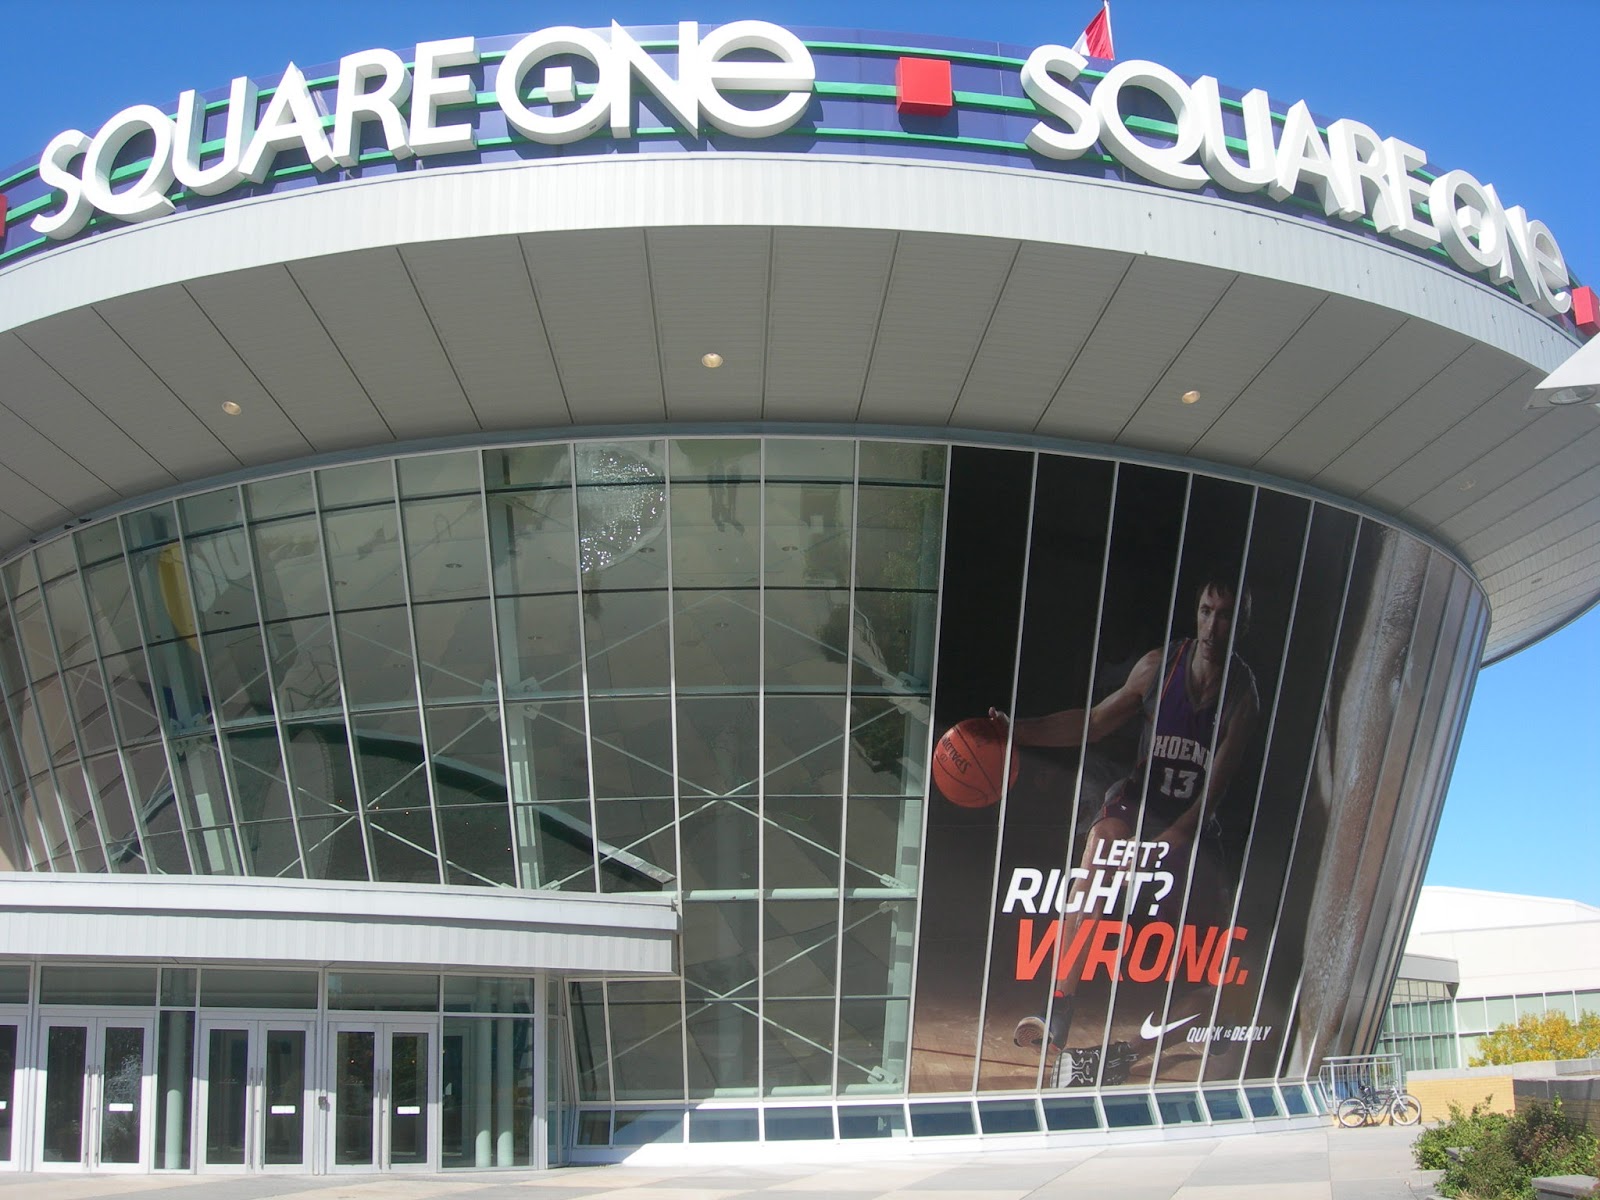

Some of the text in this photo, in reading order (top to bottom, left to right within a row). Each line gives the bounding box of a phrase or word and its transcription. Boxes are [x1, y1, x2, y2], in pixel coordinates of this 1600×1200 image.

[31, 37, 480, 242] SQUARE
[1020, 44, 1441, 250] SQUARE
[1160, 767, 1198, 798] 13
[1092, 838, 1170, 868] LEFT?
[1002, 867, 1174, 916] RIGHT?
[1015, 918, 1248, 986] WRONG.
[1230, 1026, 1272, 1041] DEADLY
